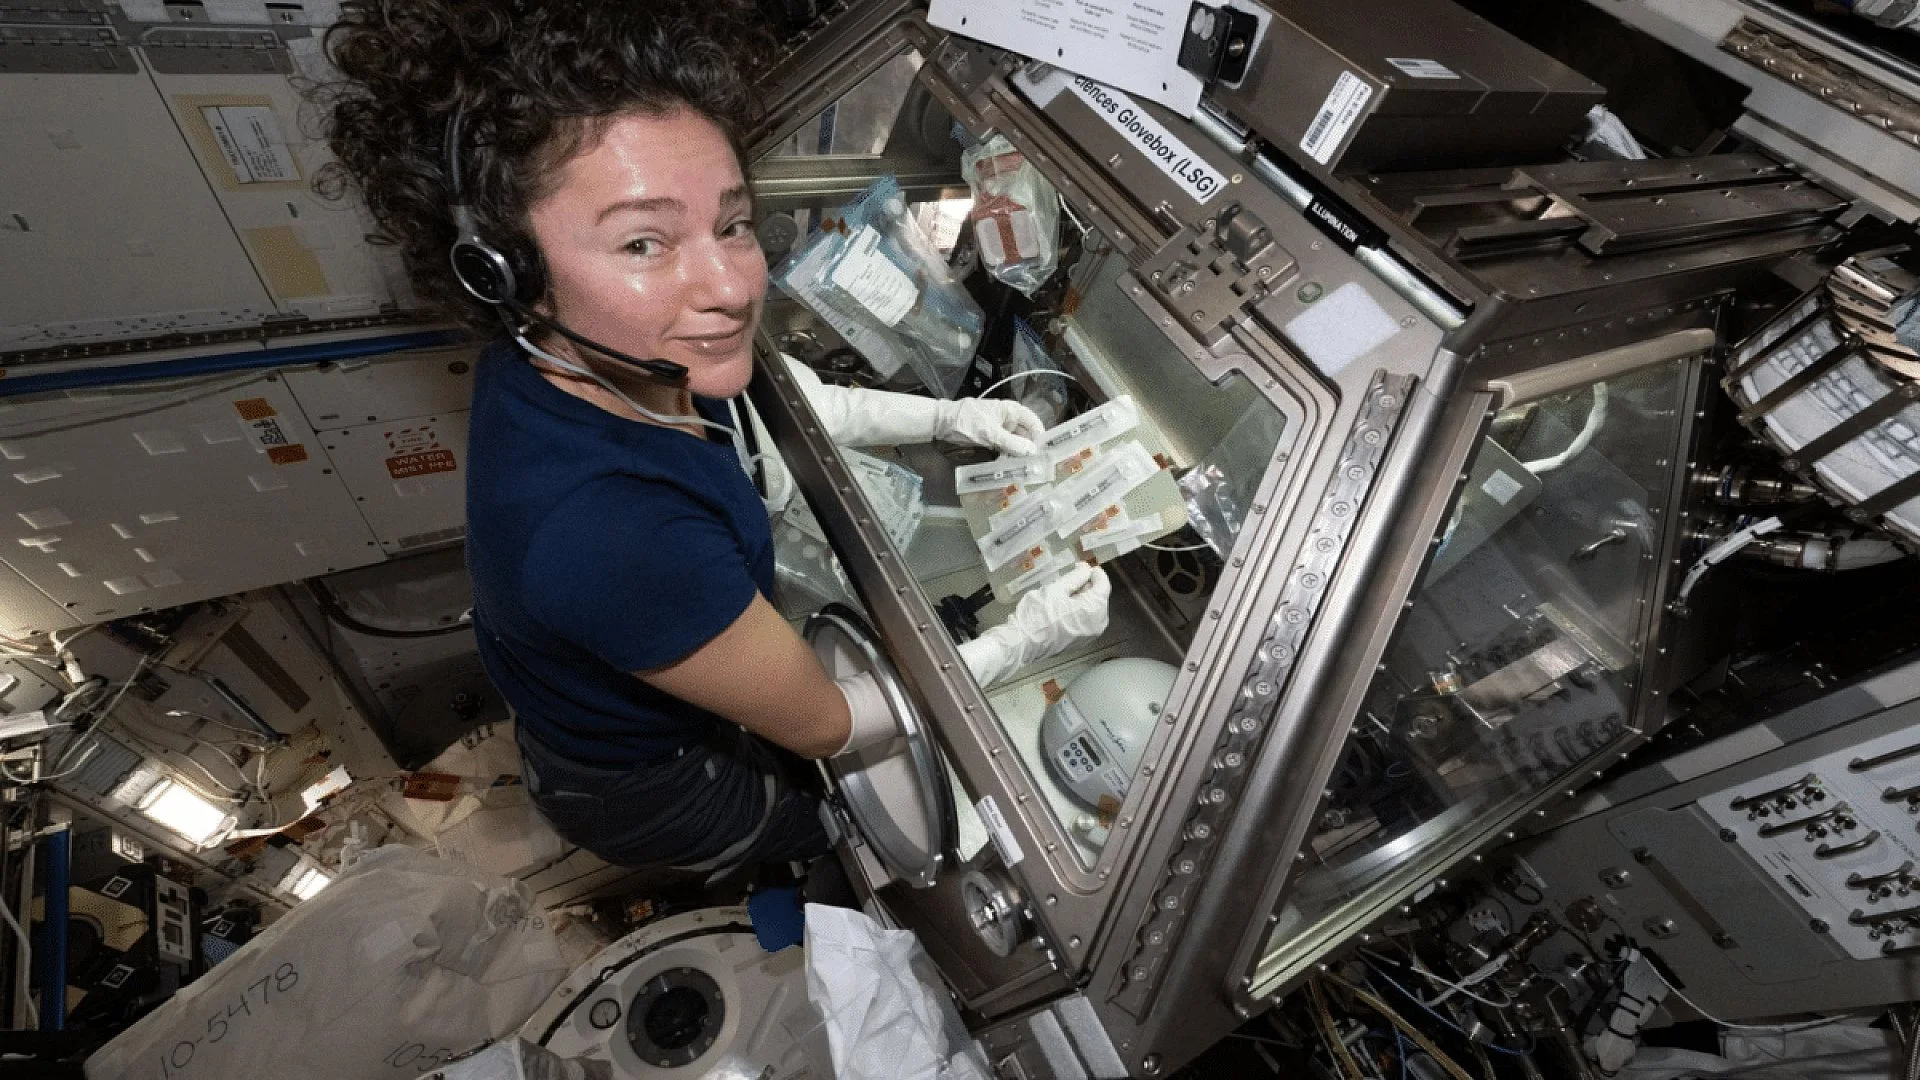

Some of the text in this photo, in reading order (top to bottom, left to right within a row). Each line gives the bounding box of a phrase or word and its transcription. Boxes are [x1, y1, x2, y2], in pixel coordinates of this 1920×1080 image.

[1118, 109, 1177, 163] Glovebox
[1171, 158, 1219, 199] (LSG)
[394, 452, 446, 466] WATER
[161, 962, 298, 1079] 10-5478
